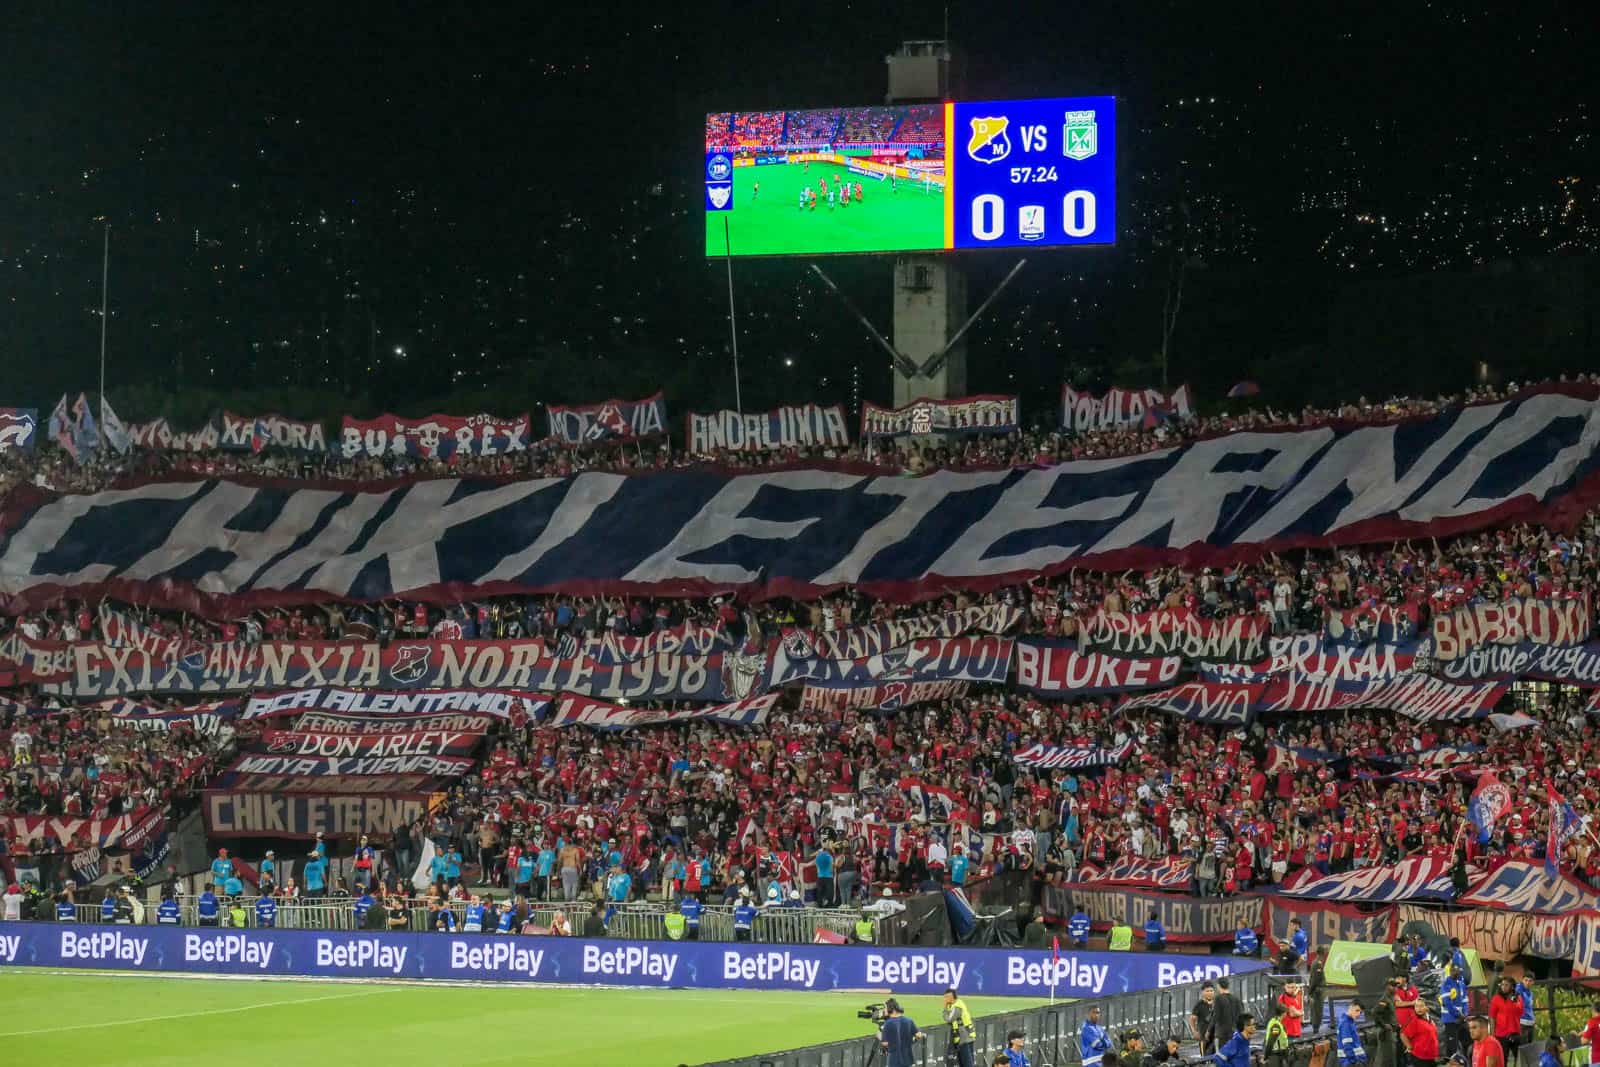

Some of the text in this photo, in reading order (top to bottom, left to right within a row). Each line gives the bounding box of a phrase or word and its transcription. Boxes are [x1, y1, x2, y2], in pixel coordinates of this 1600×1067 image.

[1020, 124, 1048, 152] VS
[1010, 166, 1059, 183] 57:24
[971, 193, 1005, 241] 0
[1063, 189, 1097, 238] 0
[912, 408, 930, 423] 25
[1, 392, 1600, 595] CHIKI ETERNO
[600, 648, 708, 698] 1998
[911, 638, 1013, 681] 2001
[298, 732, 464, 758] DON ARLEY
[354, 756, 475, 777] XIEMPRE
[210, 794, 297, 834] CHIKI
[61, 931, 148, 965] BetPlay
[185, 934, 274, 969] BetPlay
[316, 938, 408, 973] BetPlay
[450, 941, 544, 977] BetPlay
[583, 945, 678, 982] BetPlay
[723, 951, 821, 987] BetPlay
[866, 954, 966, 990] BetPlay
[1007, 956, 1109, 994] BetPlay
